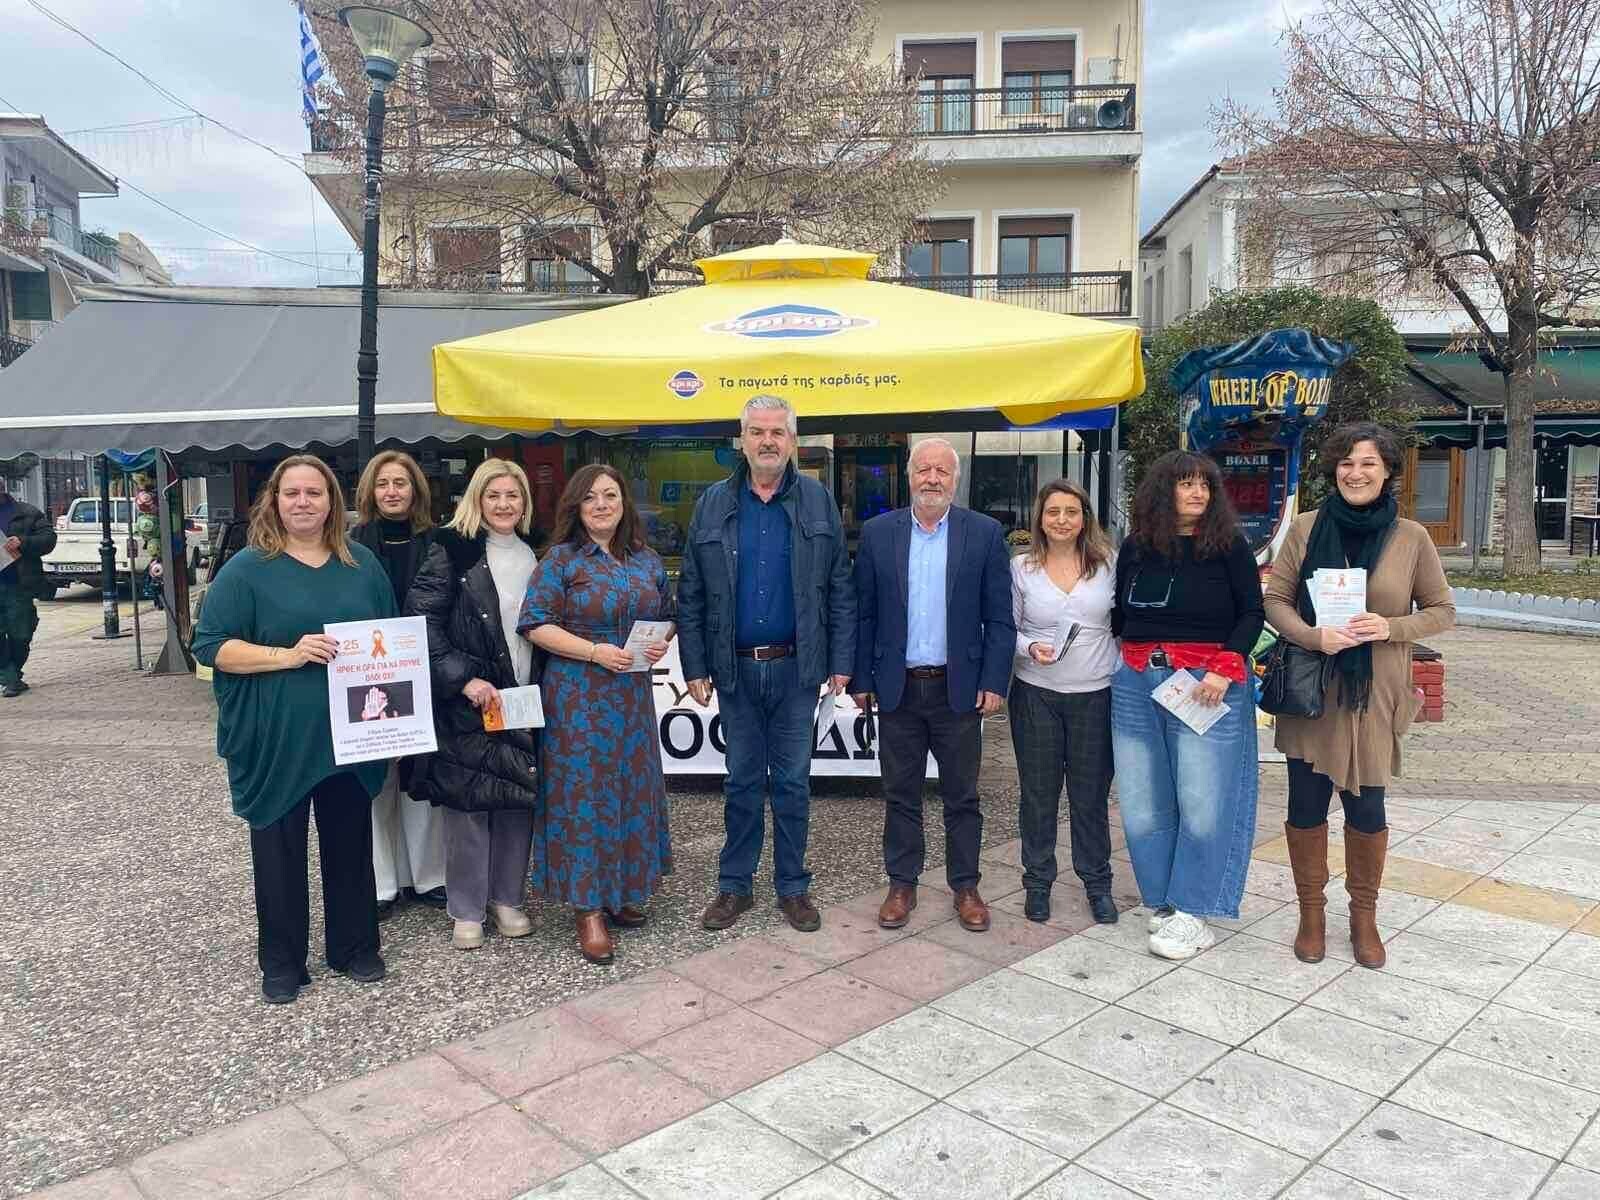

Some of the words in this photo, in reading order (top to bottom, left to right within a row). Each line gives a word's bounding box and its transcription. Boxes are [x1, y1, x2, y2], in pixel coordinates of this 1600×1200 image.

[719, 376, 734, 388] Τα
[738, 373, 788, 393] παγωτά
[792, 376, 815, 393] της
[819, 372, 870, 391] καρδιάς
[874, 373, 902, 390] μας.
[1209, 378, 1260, 407] WHEEL
[1266, 378, 1289, 408] OF
[1224, 455, 1269, 466] BOXER
[343, 639, 360, 650] 25
